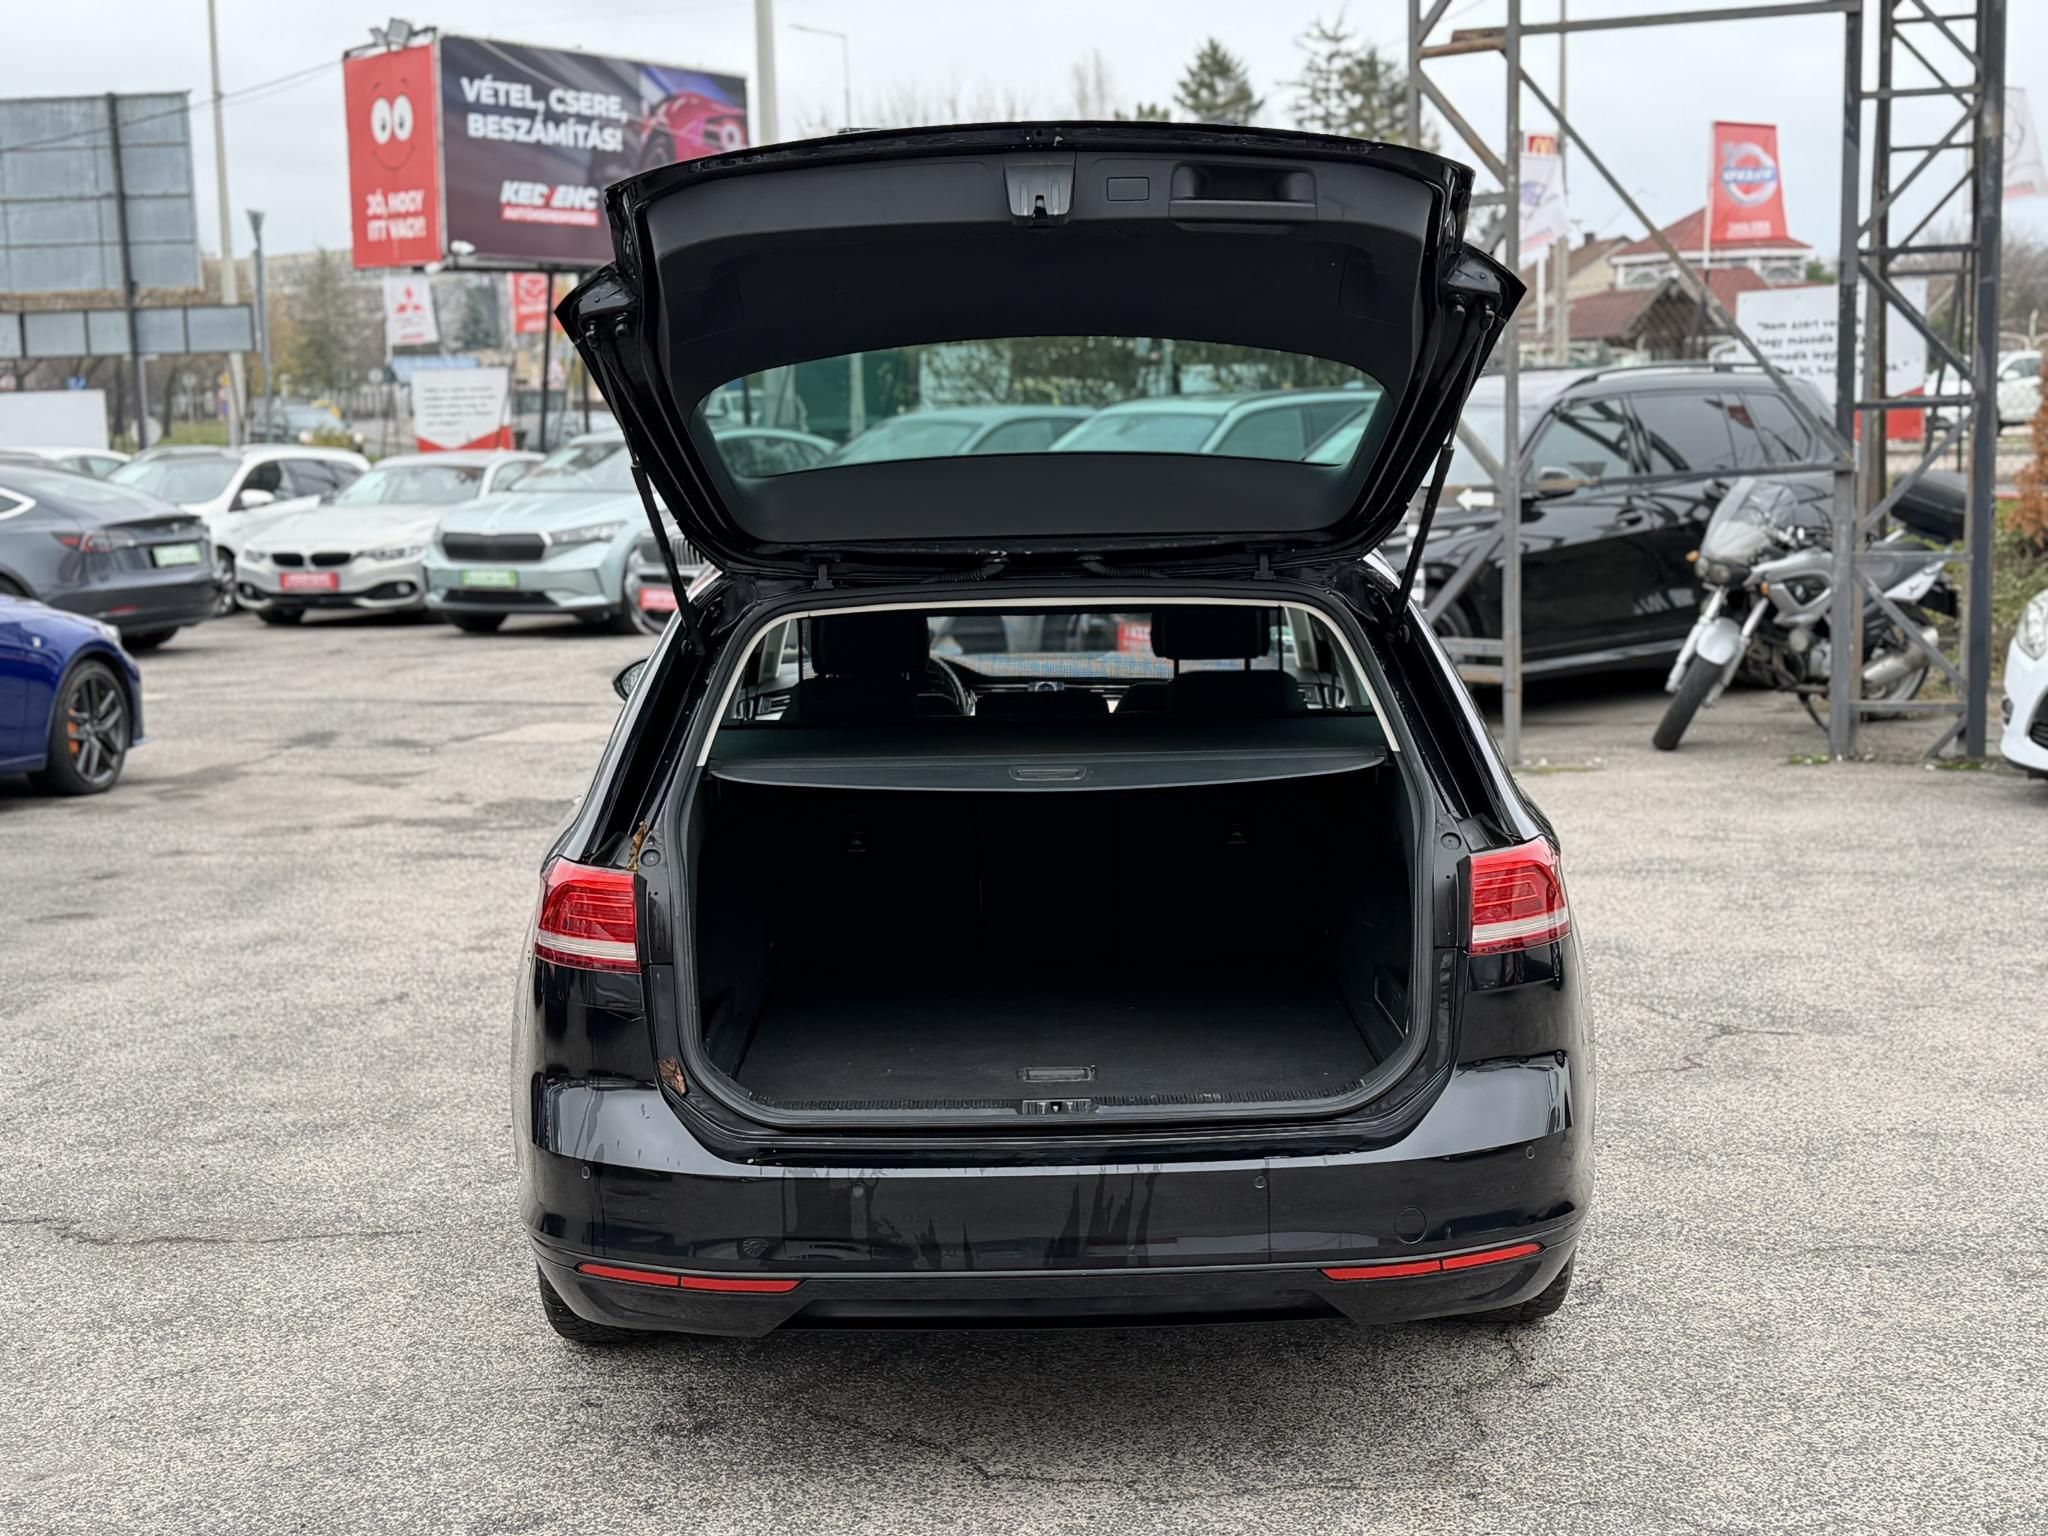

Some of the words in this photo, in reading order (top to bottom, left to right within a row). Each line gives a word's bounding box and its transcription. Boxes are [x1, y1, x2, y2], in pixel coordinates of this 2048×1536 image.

[460, 74, 545, 113] VÉTEL,
[549, 88, 628, 124] CSERE,
[467, 112, 624, 152] BESZÁMÍTÁS!
